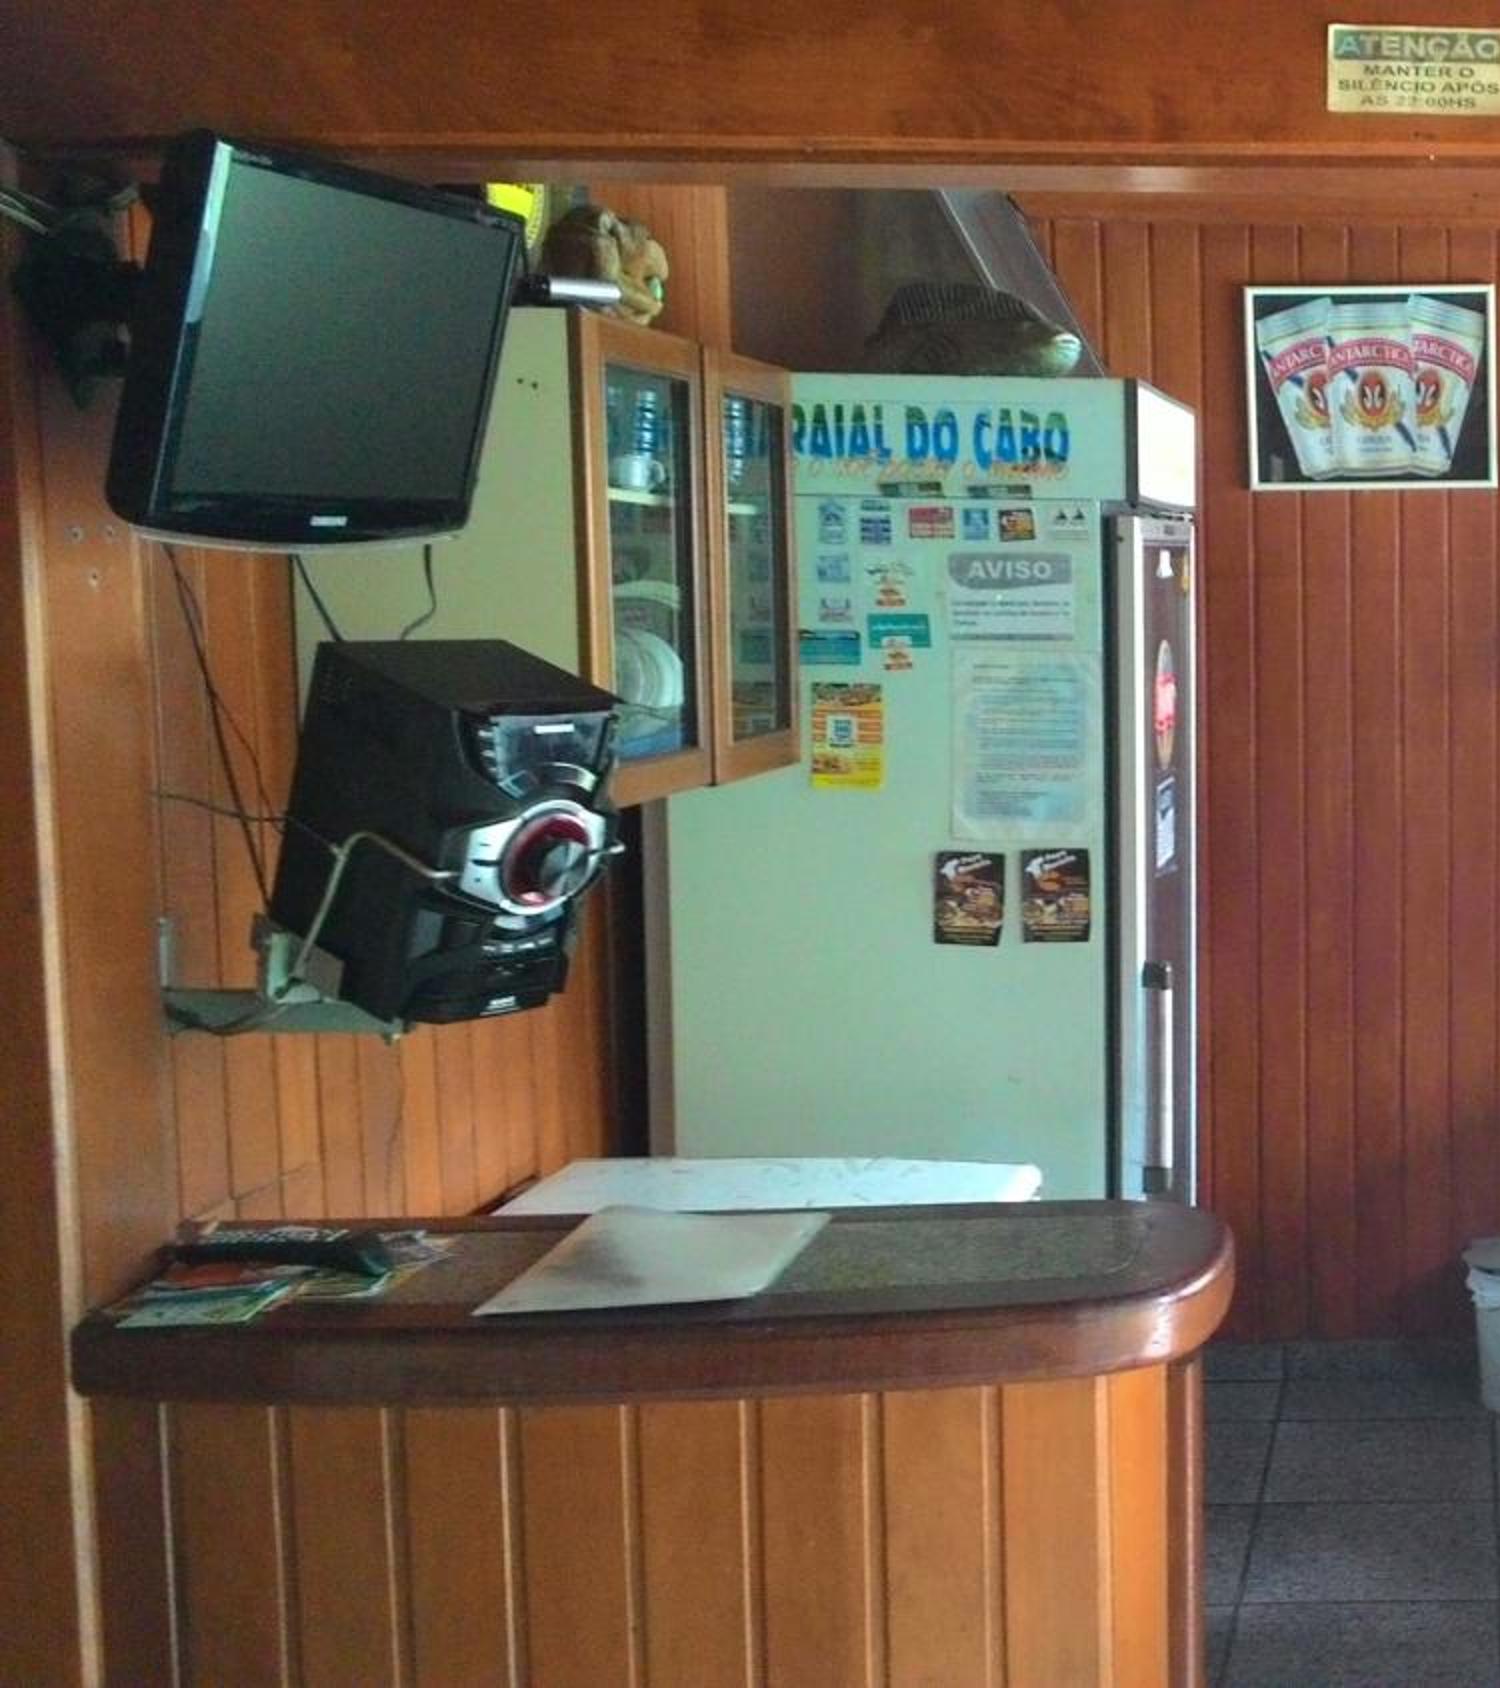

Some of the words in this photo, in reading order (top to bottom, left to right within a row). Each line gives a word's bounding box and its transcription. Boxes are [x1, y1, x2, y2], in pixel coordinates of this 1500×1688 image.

[1337, 33, 1500, 61] ATENÇÃO
[1363, 64, 1452, 79] MANTER
[1458, 66, 1475, 79] O
[1338, 78, 1436, 94] SILÊNCIO
[1441, 80, 1500, 95] APÓS
[905, 405, 959, 464] DO
[973, 408, 1070, 471] CABO
[967, 560, 1052, 580] AVISO
